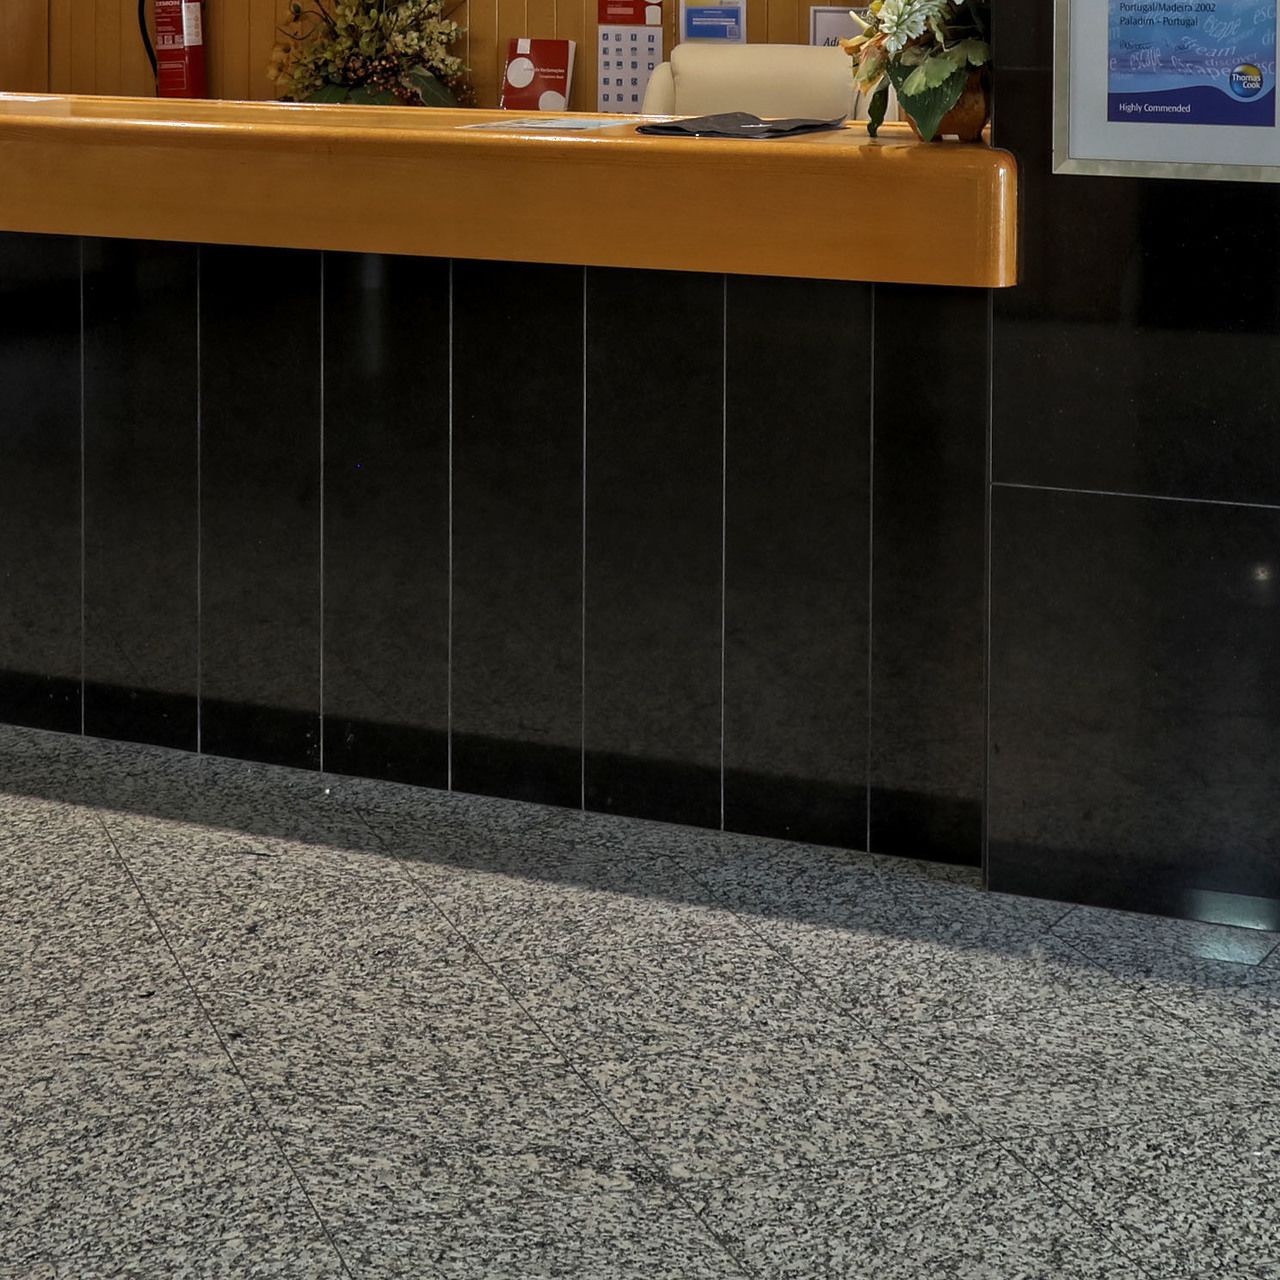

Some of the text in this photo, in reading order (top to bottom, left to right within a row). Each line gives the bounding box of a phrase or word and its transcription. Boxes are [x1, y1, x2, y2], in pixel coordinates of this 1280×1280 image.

[1120, 2, 1217, 14] Portugal/Madeira 2002
[1120, 16, 1155, 26] Paladim
[1163, 16, 1198, 27] Portugal
[1232, 74, 1261, 82] Thomas
[1242, 81, 1261, 89] Cook
[1119, 103, 1191, 114] Highly Commended
